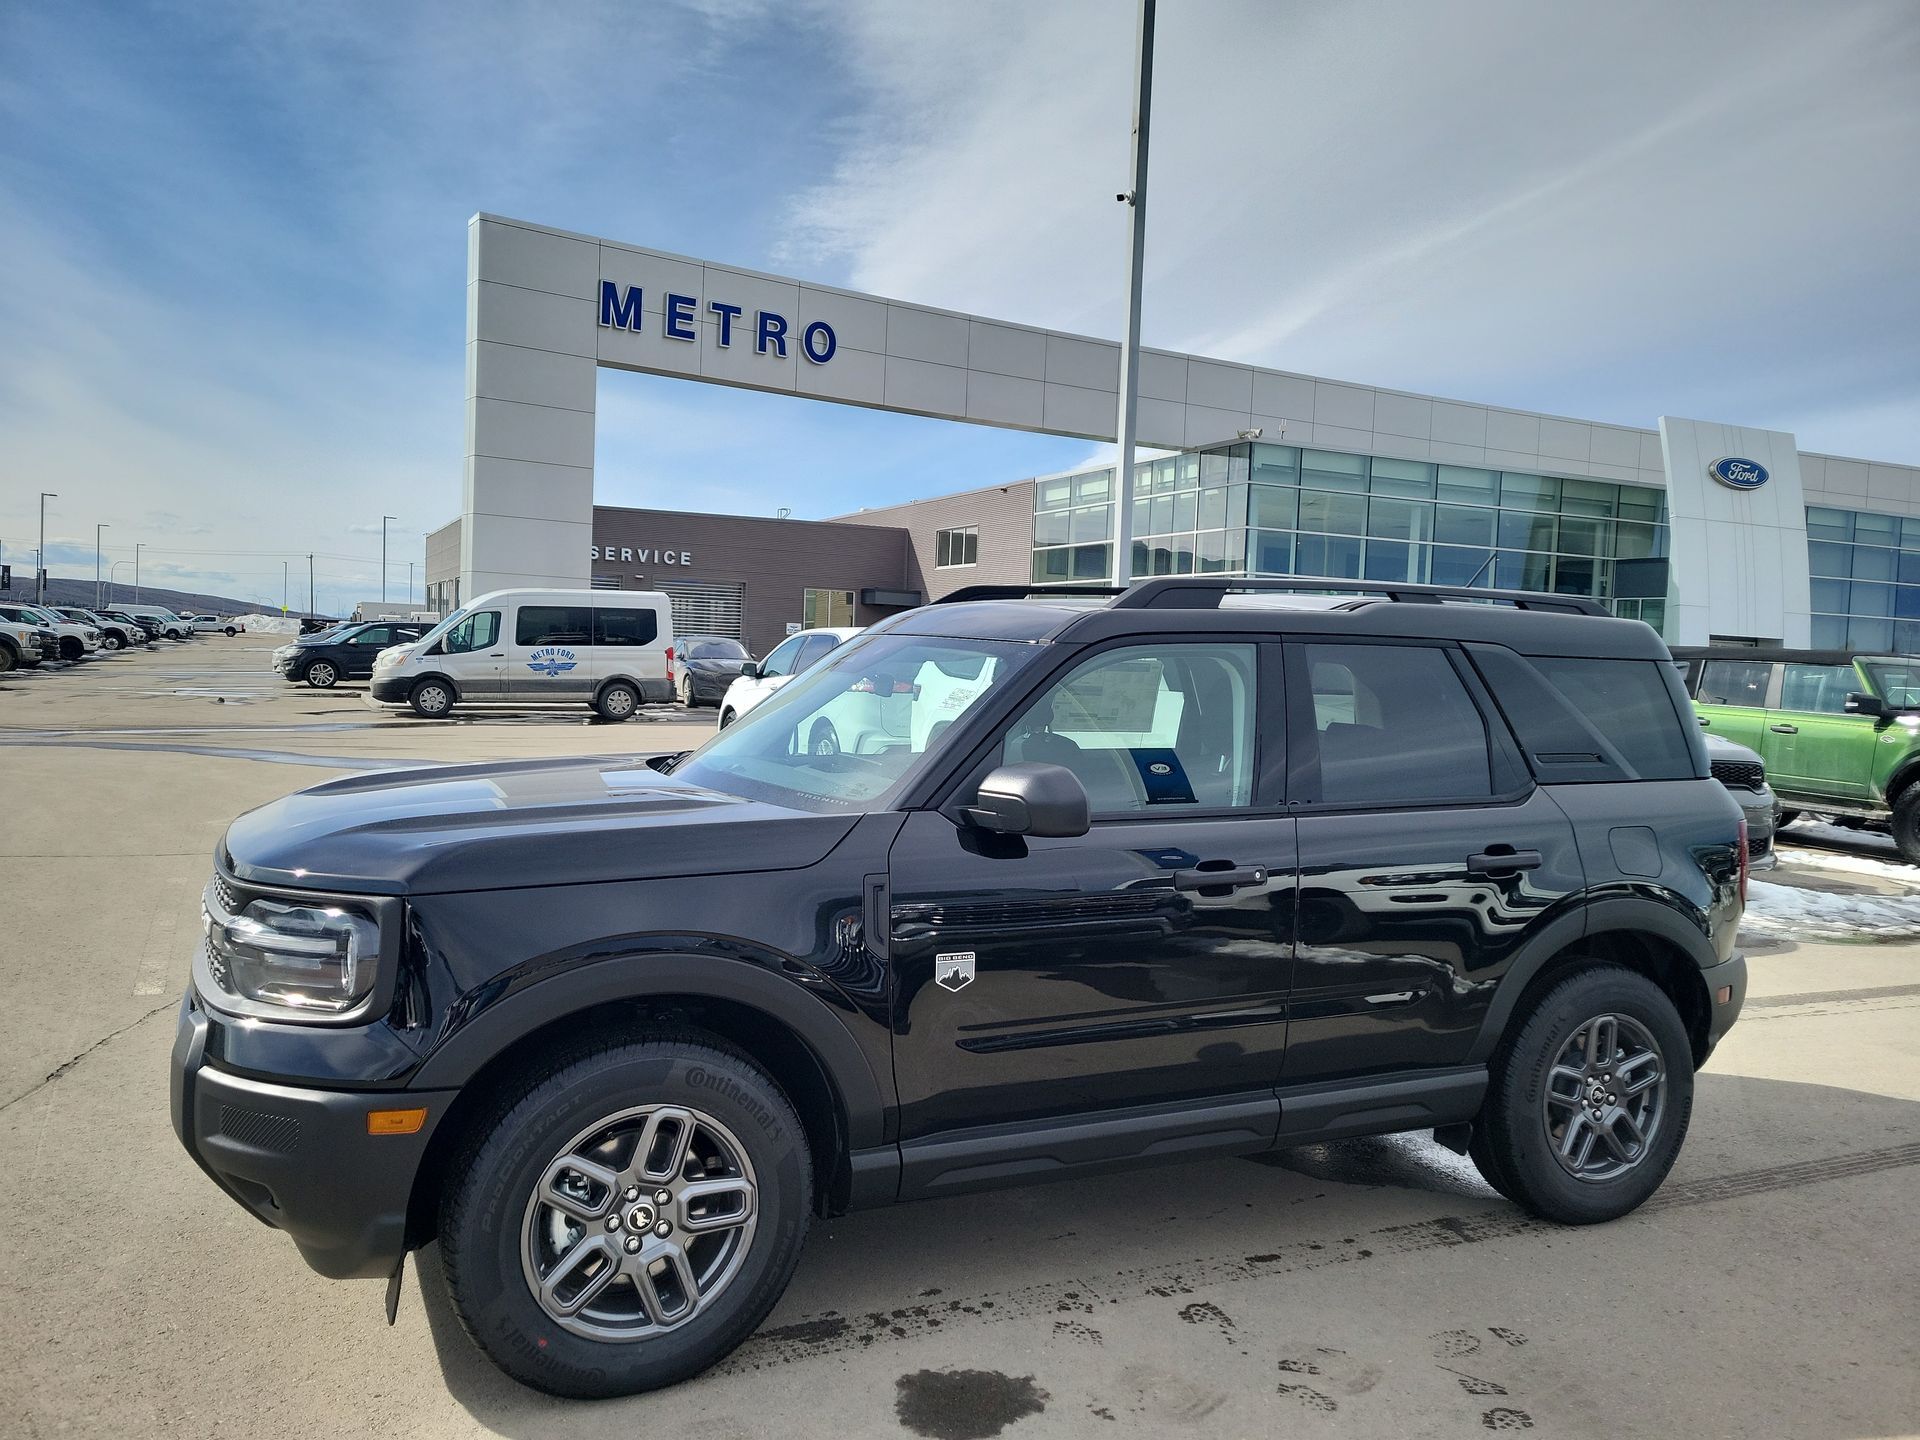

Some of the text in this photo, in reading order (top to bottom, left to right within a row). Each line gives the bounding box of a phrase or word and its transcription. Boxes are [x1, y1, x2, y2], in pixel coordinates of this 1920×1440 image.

[600, 279, 838, 365] METRO
[1728, 462, 1759, 482] Ford
[591, 545, 692, 566] SERVICE
[530, 648, 576, 662] METRO FORD
[685, 1066, 777, 1132] Continental
